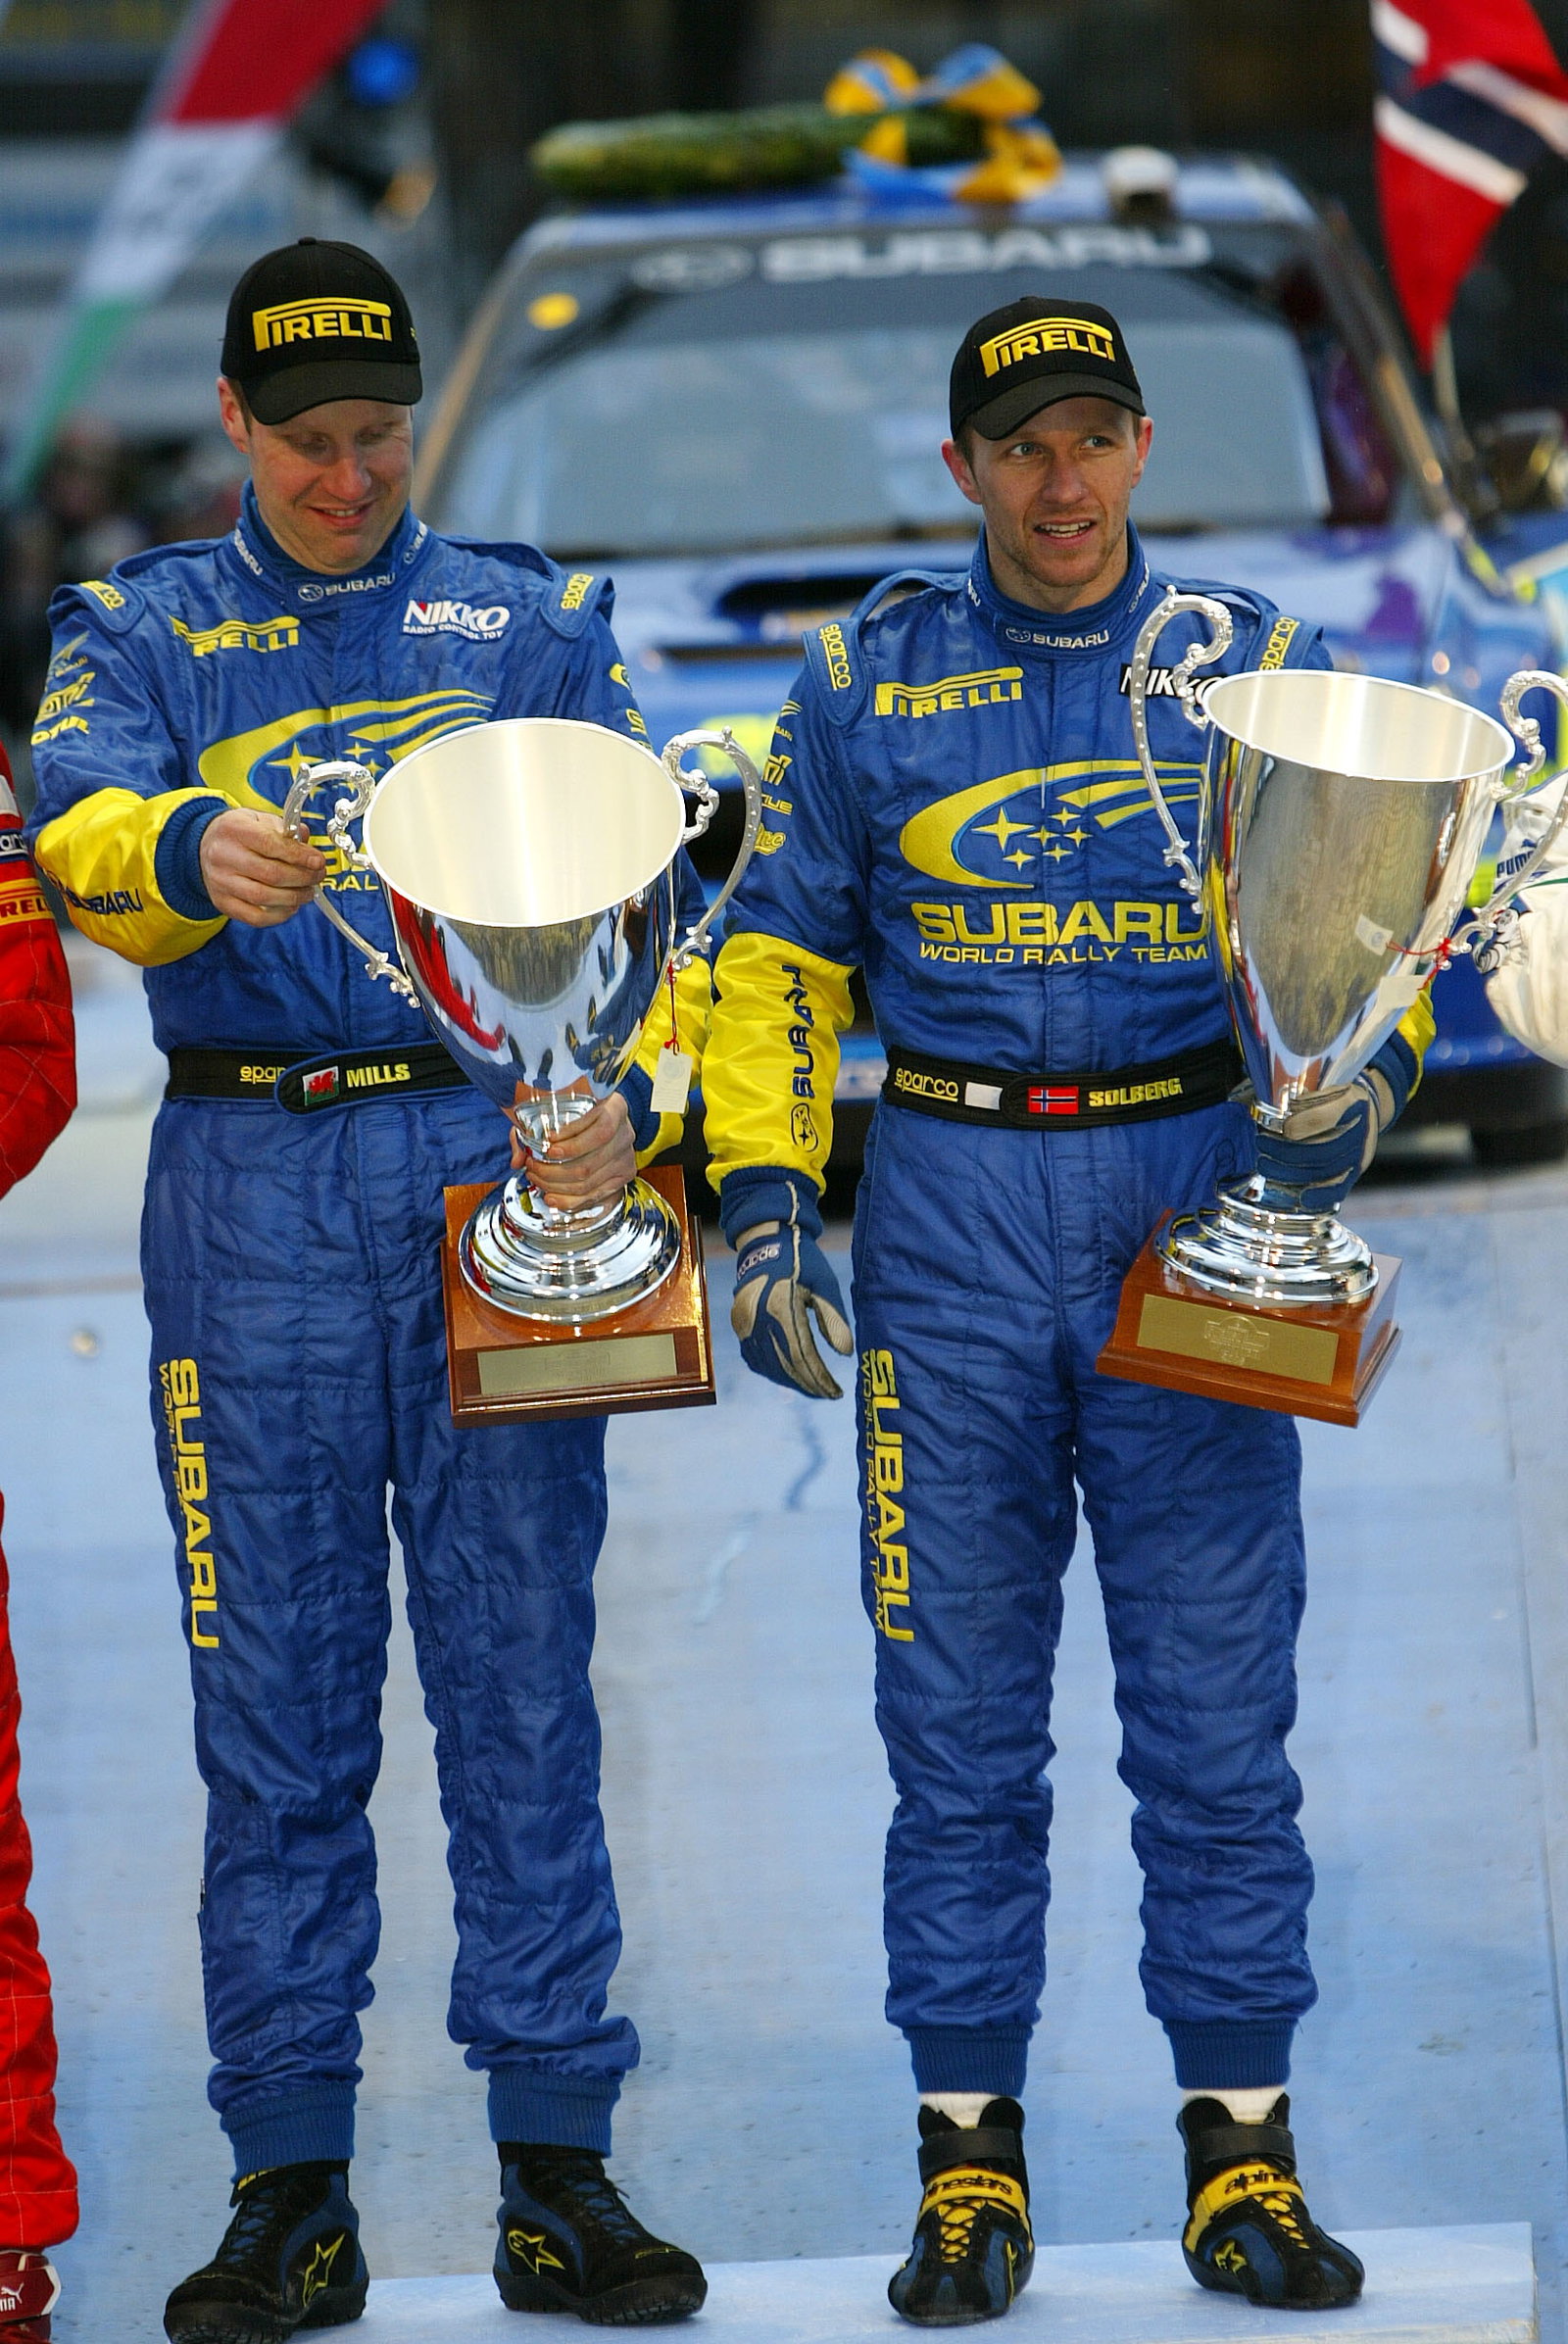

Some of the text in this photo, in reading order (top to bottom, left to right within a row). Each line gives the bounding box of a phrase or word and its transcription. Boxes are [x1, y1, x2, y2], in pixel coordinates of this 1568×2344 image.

[760, 226, 1213, 282] SUBARU
[252, 297, 393, 353] PIRELLI
[979, 317, 1116, 378] PIRELLI
[324, 572, 396, 597] SUBARU
[402, 622, 505, 640] RADIO CONTROL TOY
[403, 599, 511, 632] NIKKO
[1032, 628, 1110, 650] SUBARU
[818, 623, 853, 691] sparco
[874, 666, 1024, 718] PIRELLI
[319, 873, 379, 892] RAL
[910, 901, 1209, 947] SUBARU
[918, 943, 1208, 966] WORLD RALLY TEAM
[780, 963, 816, 1100] SUBARU
[239, 1063, 412, 1089] spar MILLS
[893, 1067, 1184, 1109] sparco SOLBERG
[169, 1358, 220, 1649] SUBARU
[865, 1457, 880, 1547] RALLY
[869, 1347, 915, 1643] SUBARU
